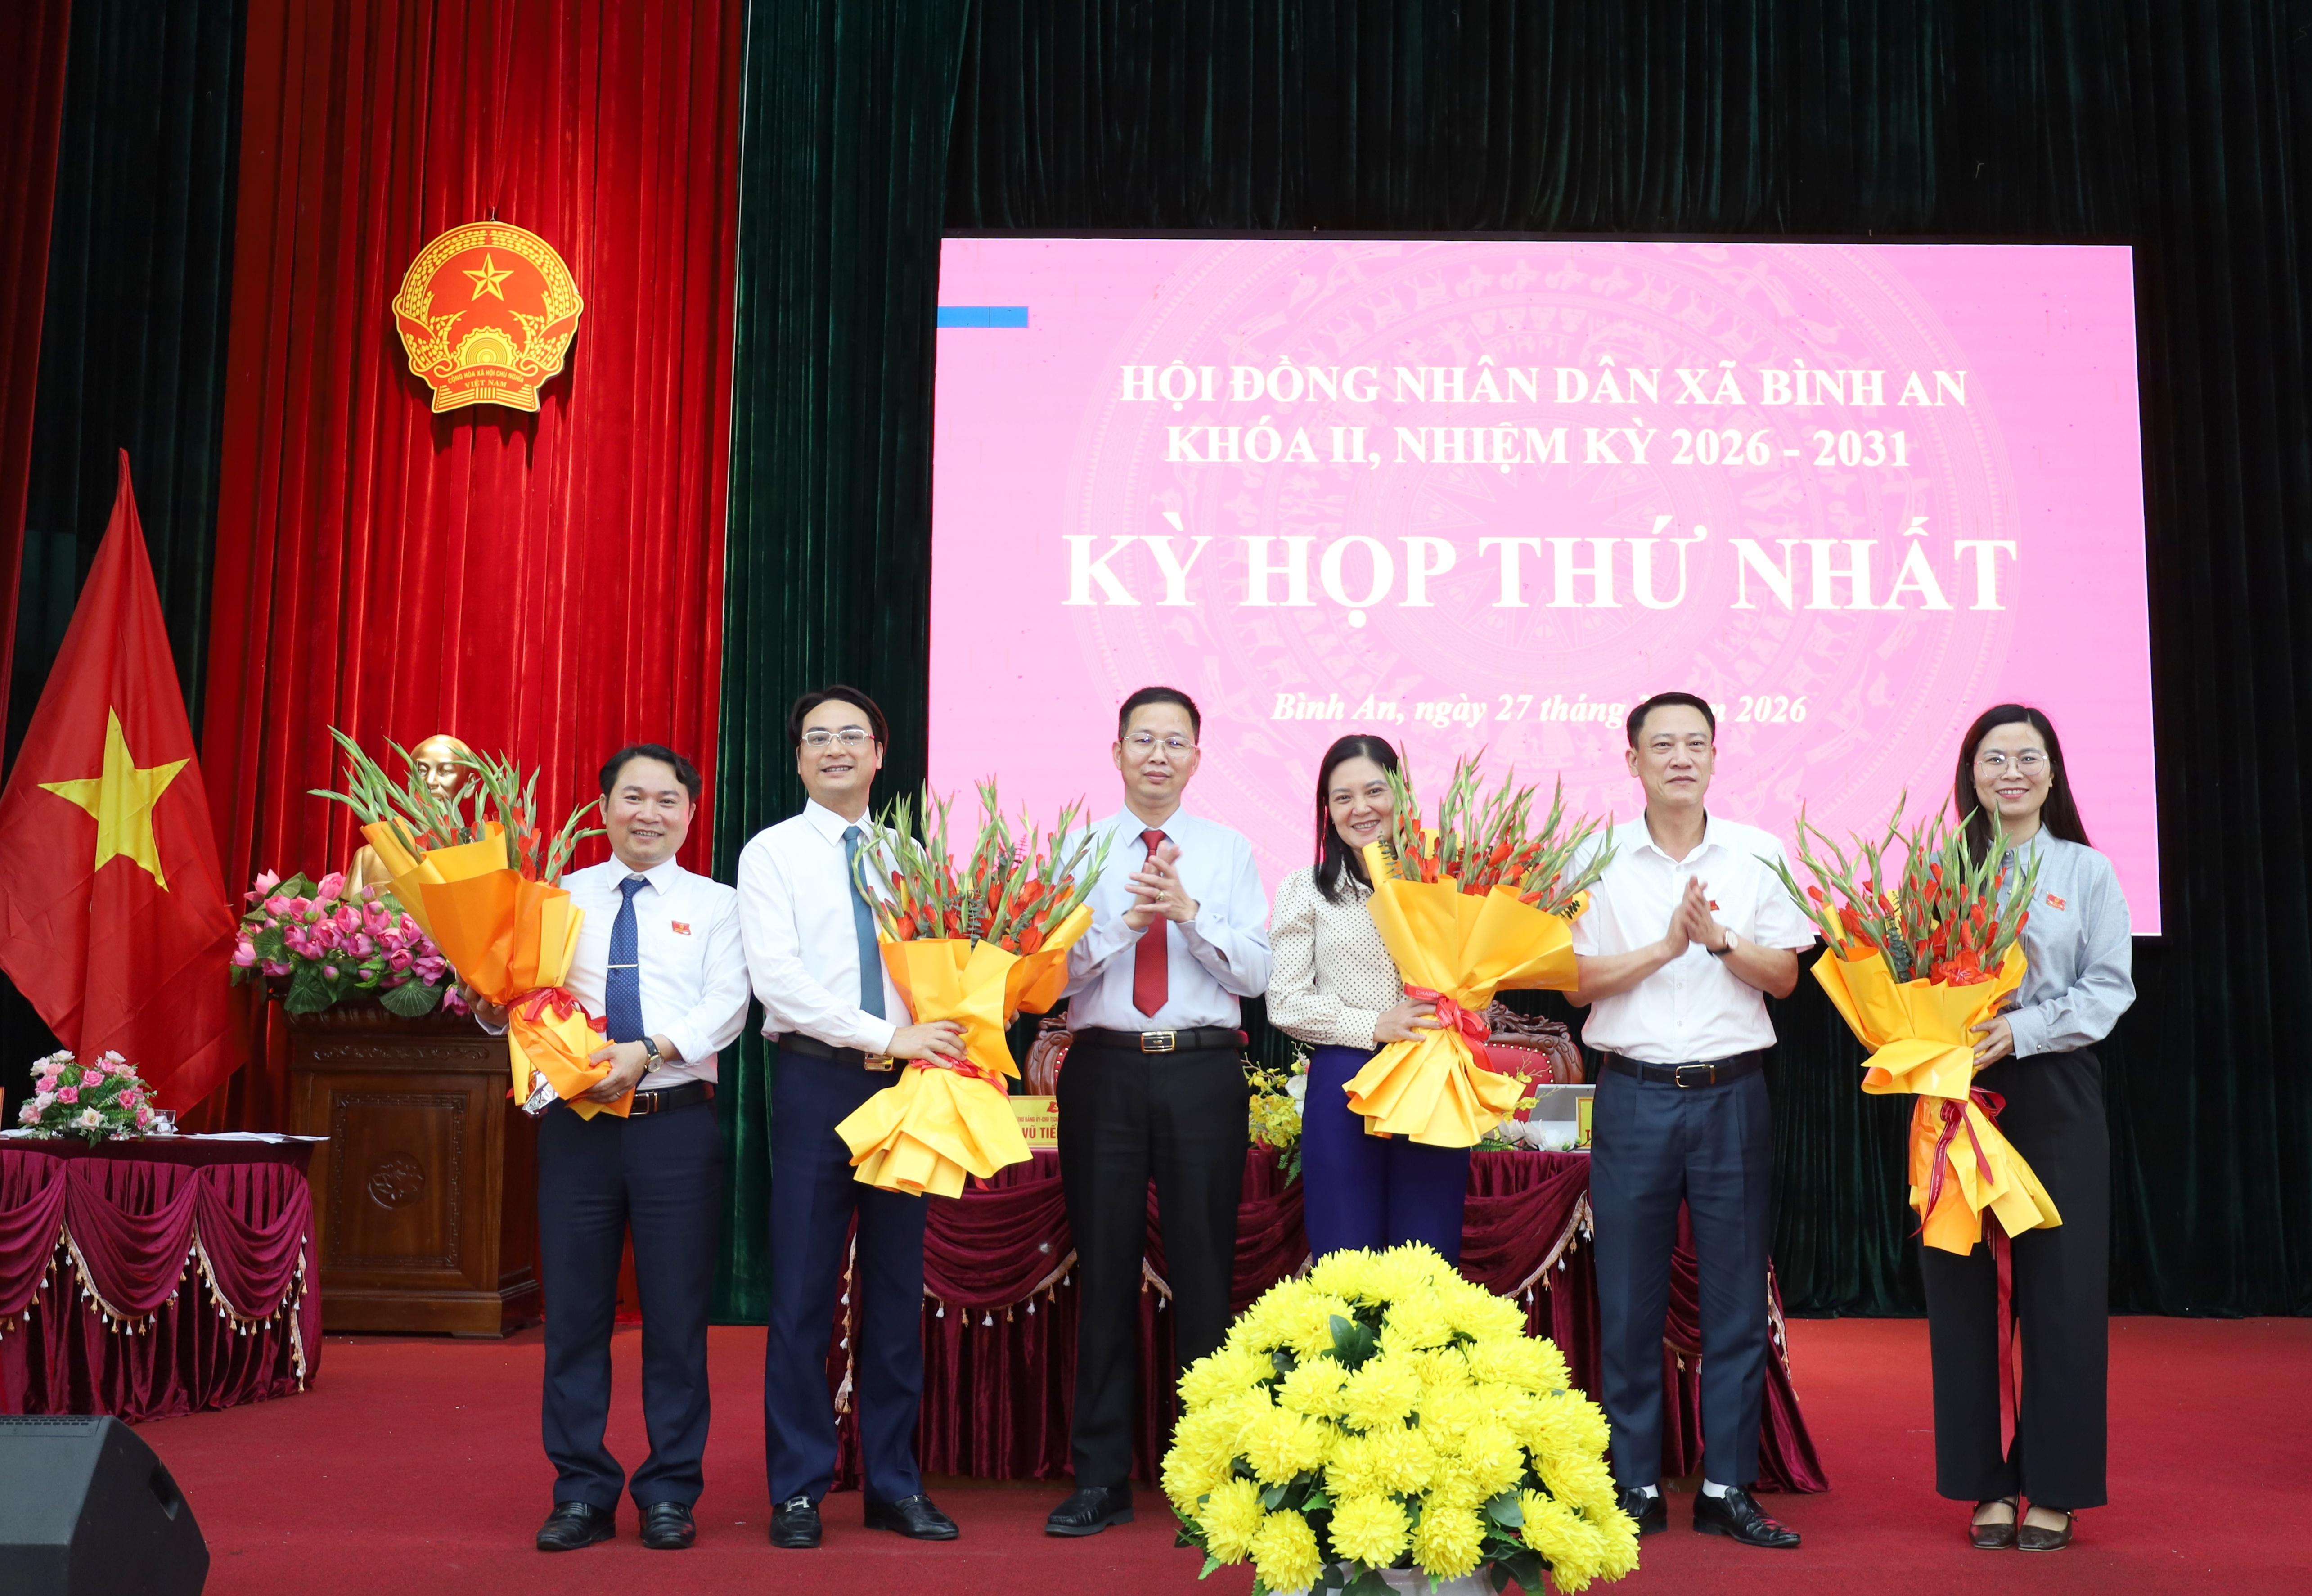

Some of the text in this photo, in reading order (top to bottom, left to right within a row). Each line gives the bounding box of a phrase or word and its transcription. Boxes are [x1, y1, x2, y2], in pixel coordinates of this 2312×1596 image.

[465, 379, 486, 388] VIỆT
[1120, 355, 1966, 411] HỘI ĐỒNG NHÂN DÂN XÃ BÌNH AN
[1165, 416, 1319, 463] KHÓA
[1329, 427, 1380, 470] II,
[1394, 422, 1569, 474] NHIỆM
[1583, 418, 1657, 464] KỲ
[1671, 429, 1771, 466] 2026
[1813, 430, 1909, 466] 2031
[1062, 512, 2017, 628] KỲ HỌP THỨ NHẤT
[1270, 692, 1345, 720] Bình
[1351, 693, 1404, 725] An,
[1415, 693, 1487, 728] ngày
[1495, 694, 1533, 720] 27
[1539, 693, 1626, 729] tháng
[1735, 696, 1807, 722] 2026
[1022, 1123, 1057, 1138] VŨ TIẾ
